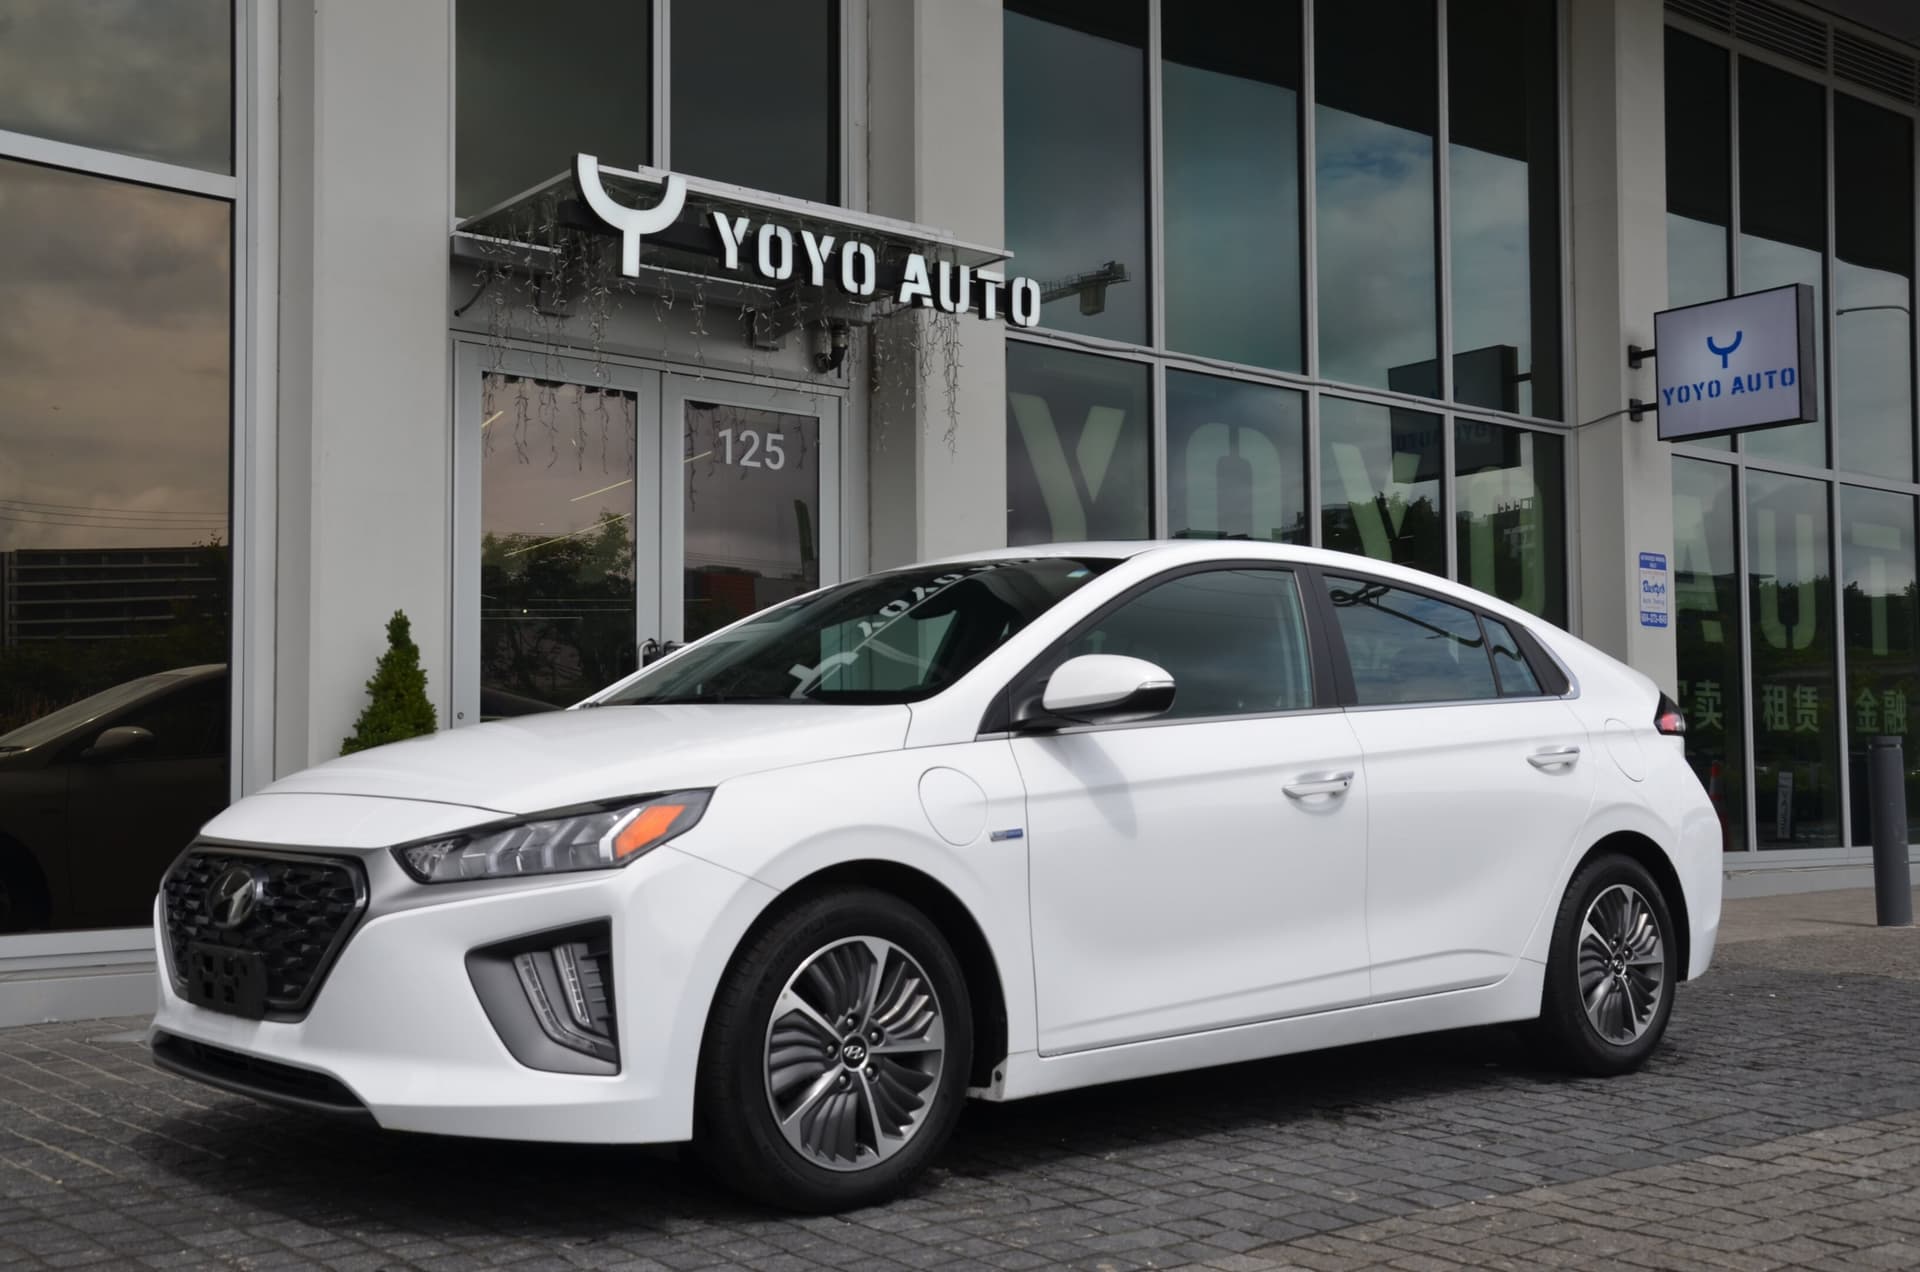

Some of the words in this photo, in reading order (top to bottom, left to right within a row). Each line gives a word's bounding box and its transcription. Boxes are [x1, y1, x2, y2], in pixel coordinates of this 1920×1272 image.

[711, 211, 877, 296] YOYO
[899, 253, 1042, 329] AUTO
[1662, 379, 1721, 407] YOYO
[1731, 367, 1796, 396] AUTO
[718, 428, 786, 471] 125
[1855, 688, 1909, 735] 金融
